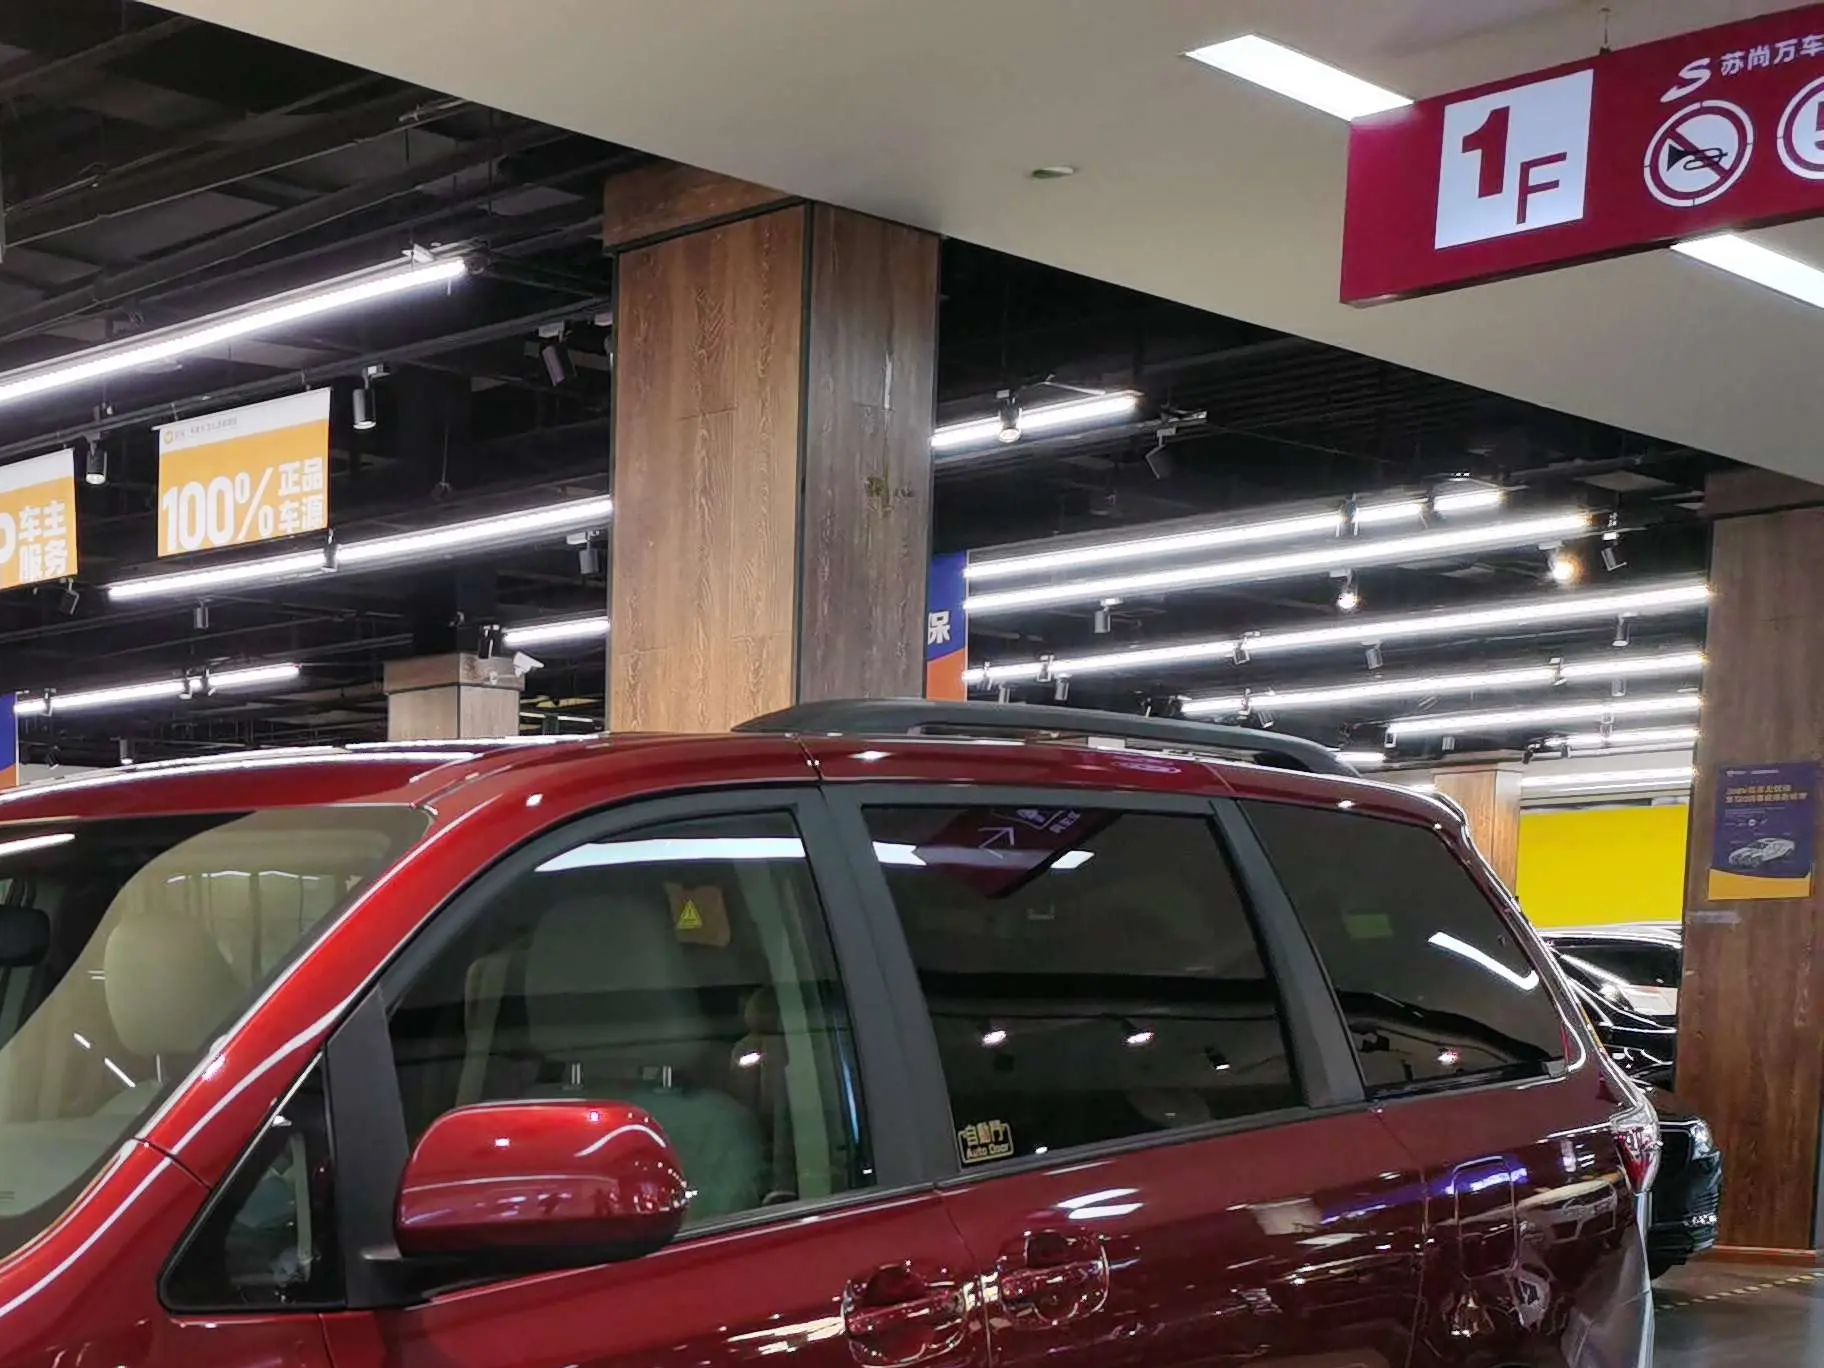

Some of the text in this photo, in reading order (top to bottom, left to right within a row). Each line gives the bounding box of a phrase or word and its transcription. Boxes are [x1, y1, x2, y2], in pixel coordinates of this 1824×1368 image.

[277, 456, 323, 497] 正品
[18, 500, 67, 541] 车主
[162, 466, 275, 553] 100%
[277, 494, 324, 534] 车源
[19, 539, 68, 584] 服务
